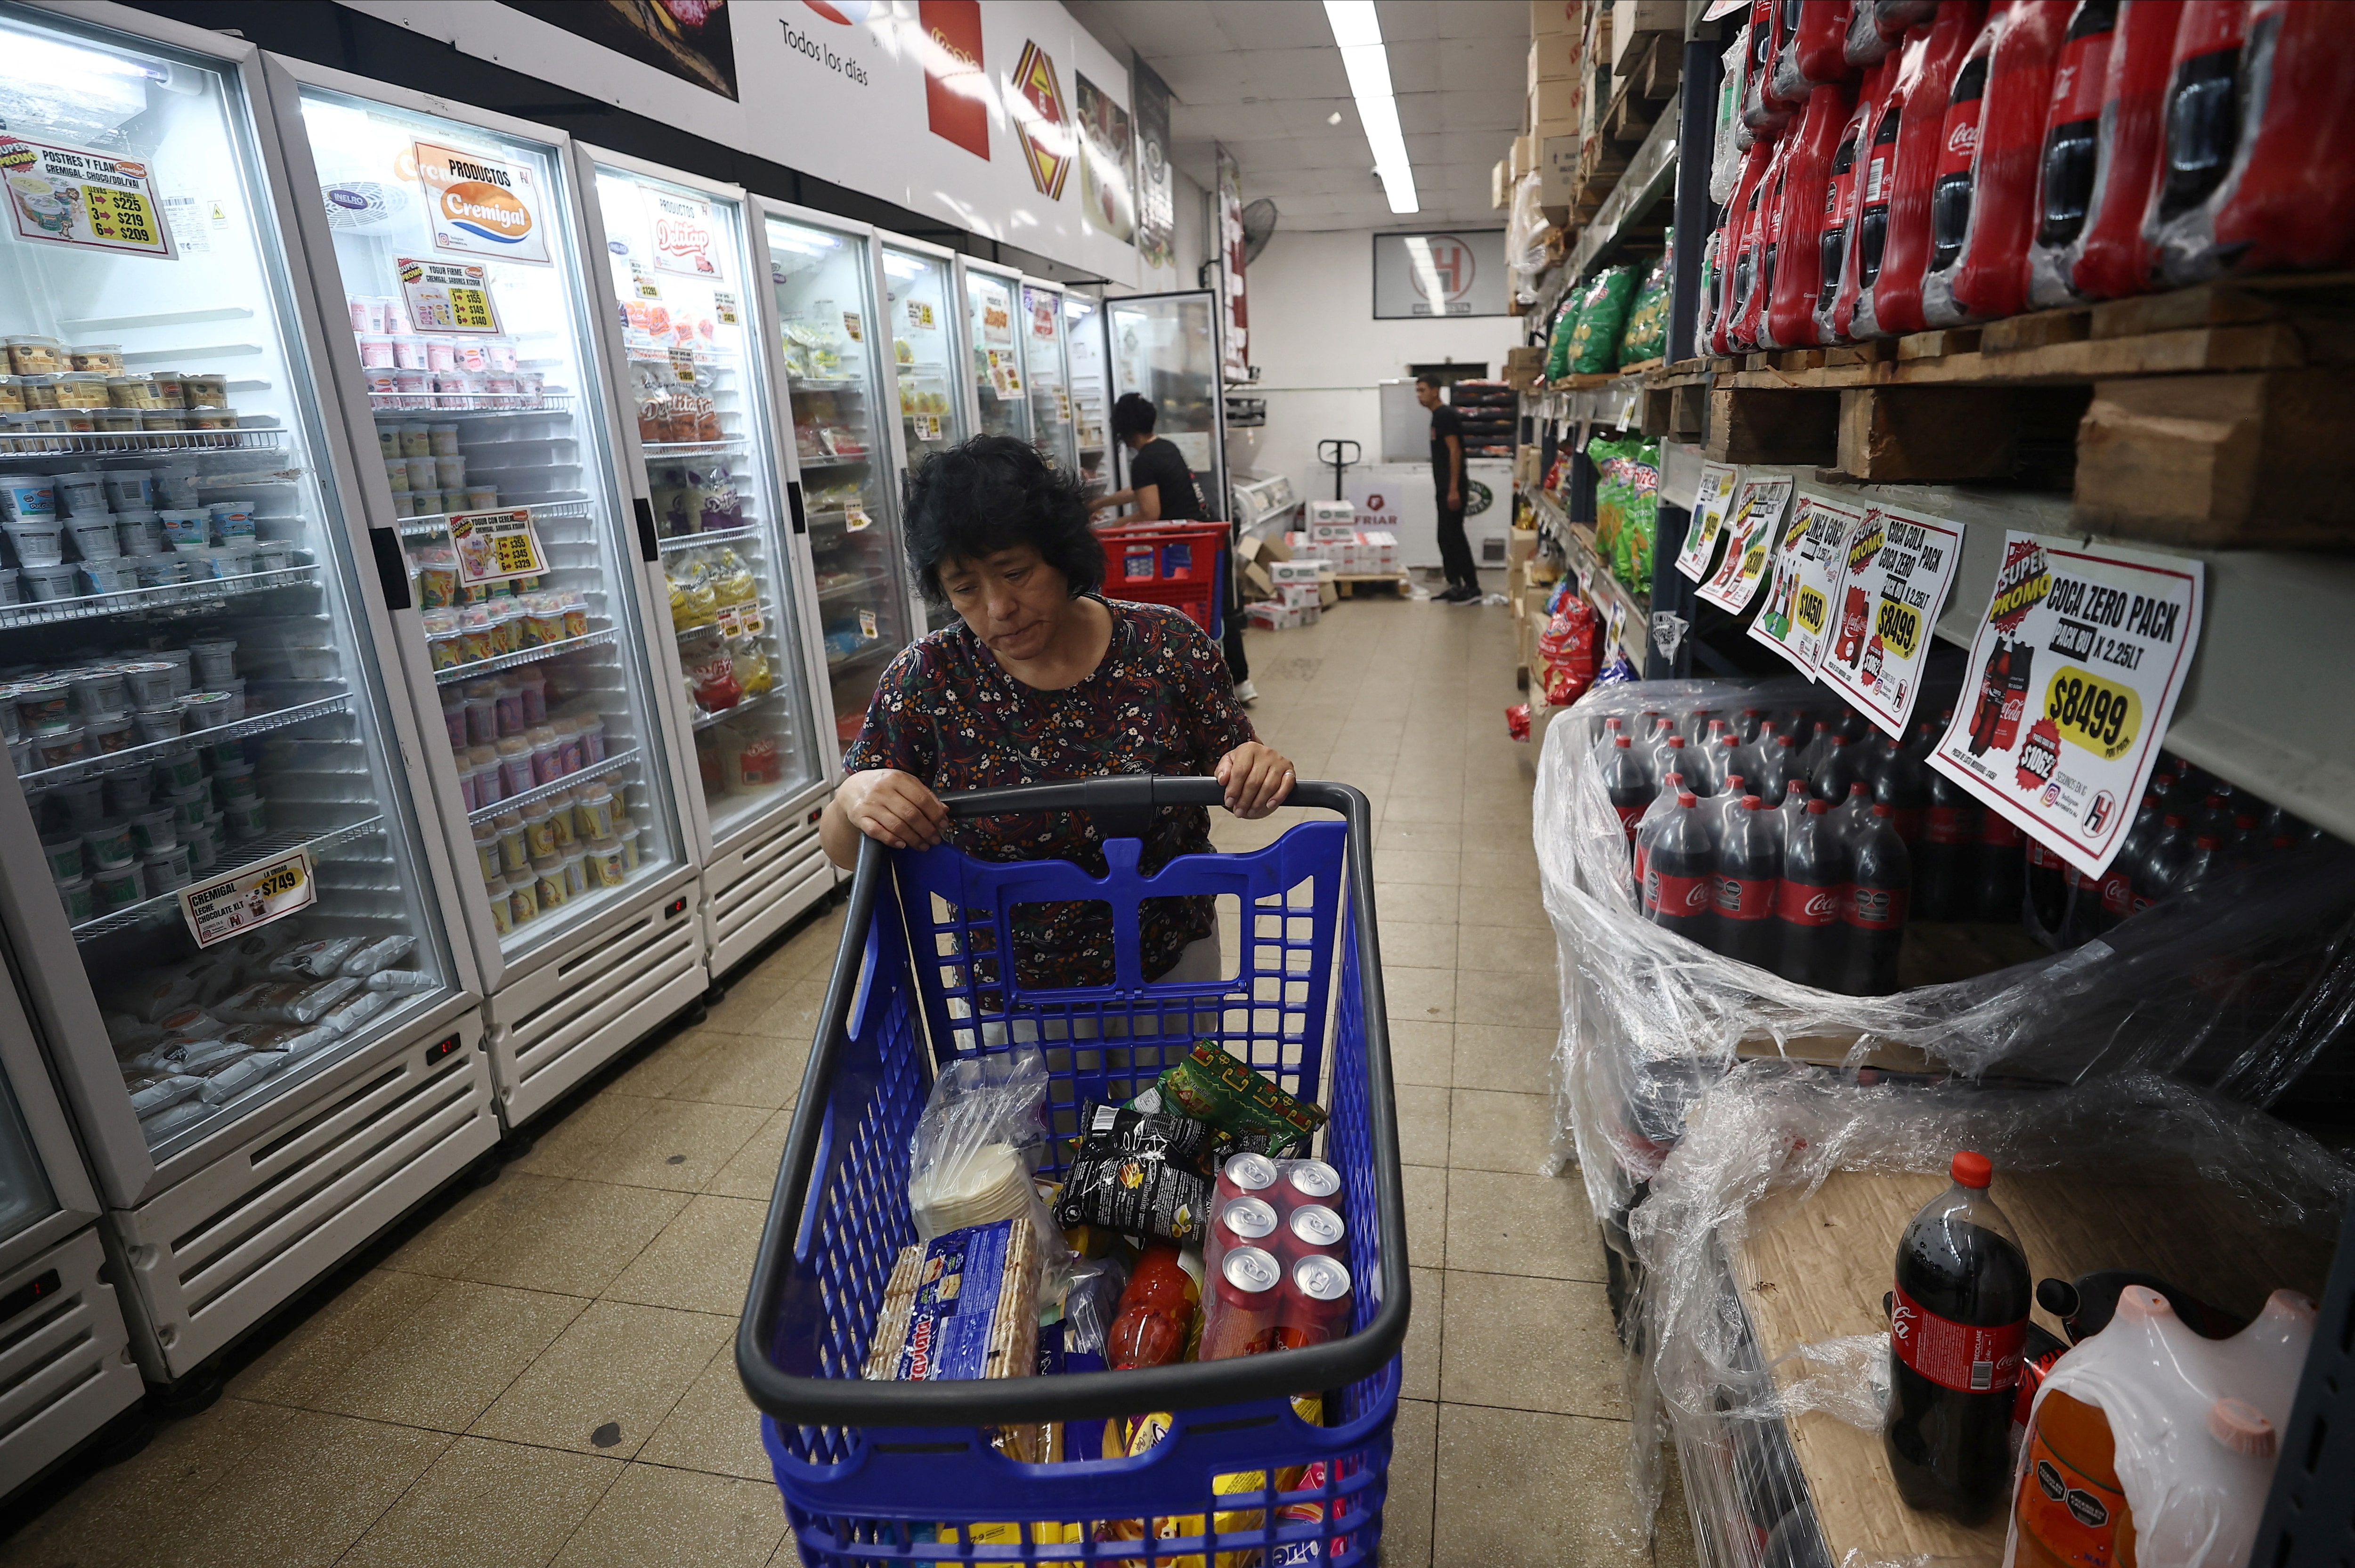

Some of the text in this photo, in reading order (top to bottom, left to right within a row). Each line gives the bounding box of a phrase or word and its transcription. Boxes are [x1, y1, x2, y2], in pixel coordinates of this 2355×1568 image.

[779, 18, 869, 87] Todos los días
[0, 141, 29, 156] UPER
[42, 150, 83, 166] POSTRES
[94, 160, 115, 173] FLAN
[116, 163, 145, 176] Cremigal
[448, 159, 511, 187] PRODUCTOS
[88, 193, 141, 212] 1 $225
[334, 192, 364, 205] INELRO
[659, 198, 695, 219] PRODUCTOS
[93, 208, 144, 226] 3 $219
[446, 192, 525, 228] Cremigal
[96, 223, 104, 235] 6
[122, 227, 150, 242] $209
[399, 263, 418, 273] SUPER
[402, 268, 423, 281] PROMO
[429, 266, 463, 276] YOGUR FIRME
[454, 293, 481, 303] 1 $155
[455, 304, 484, 314] 3 $149
[457, 315, 487, 325] 6 $140
[452, 519, 468, 531] SUPER
[454, 522, 473, 537] PROMO
[471, 518, 487, 526] YOGUR
[1355, 515, 1397, 524] FRIAR
[1806, 512, 1828, 541] LINEA
[1853, 516, 1883, 544] SUPER
[511, 539, 526, 548] $355
[1887, 520, 1926, 552] COCA COLA
[499, 550, 528, 561] 3 $345
[1849, 531, 1884, 566] PROMO
[1922, 544, 1944, 573] PACK
[514, 560, 530, 569] $329
[1878, 548, 1916, 578] COCA ZERO
[2000, 550, 2048, 591] SUPER
[1904, 586, 1910, 601] X
[1909, 589, 1930, 610] 2.25LT
[1989, 572, 2052, 623] PROMO
[1799, 591, 1822, 627] $1450
[2046, 577, 2180, 643] COCA ZERO PACK
[1878, 604, 1916, 650] $8499
[2053, 624, 2076, 650] PACK
[2094, 634, 2105, 657] X
[2103, 639, 2145, 671] 2.25LT
[2050, 675, 2128, 747] $8499
[2021, 744, 2054, 779] $1062
[270, 865, 287, 877] UNIDAD
[191, 883, 237, 907] CREMIGAL
[262, 872, 296, 897] $749
[194, 903, 215, 916] LECHE
[197, 906, 232, 925] CHOCOLATE
[1140, 1184, 1152, 1212] Cheddar
[907, 1314, 933, 1381] raviata
[1974, 1330, 1982, 1361] RECICLAME
[970, 1533, 985, 1544] 7-9
